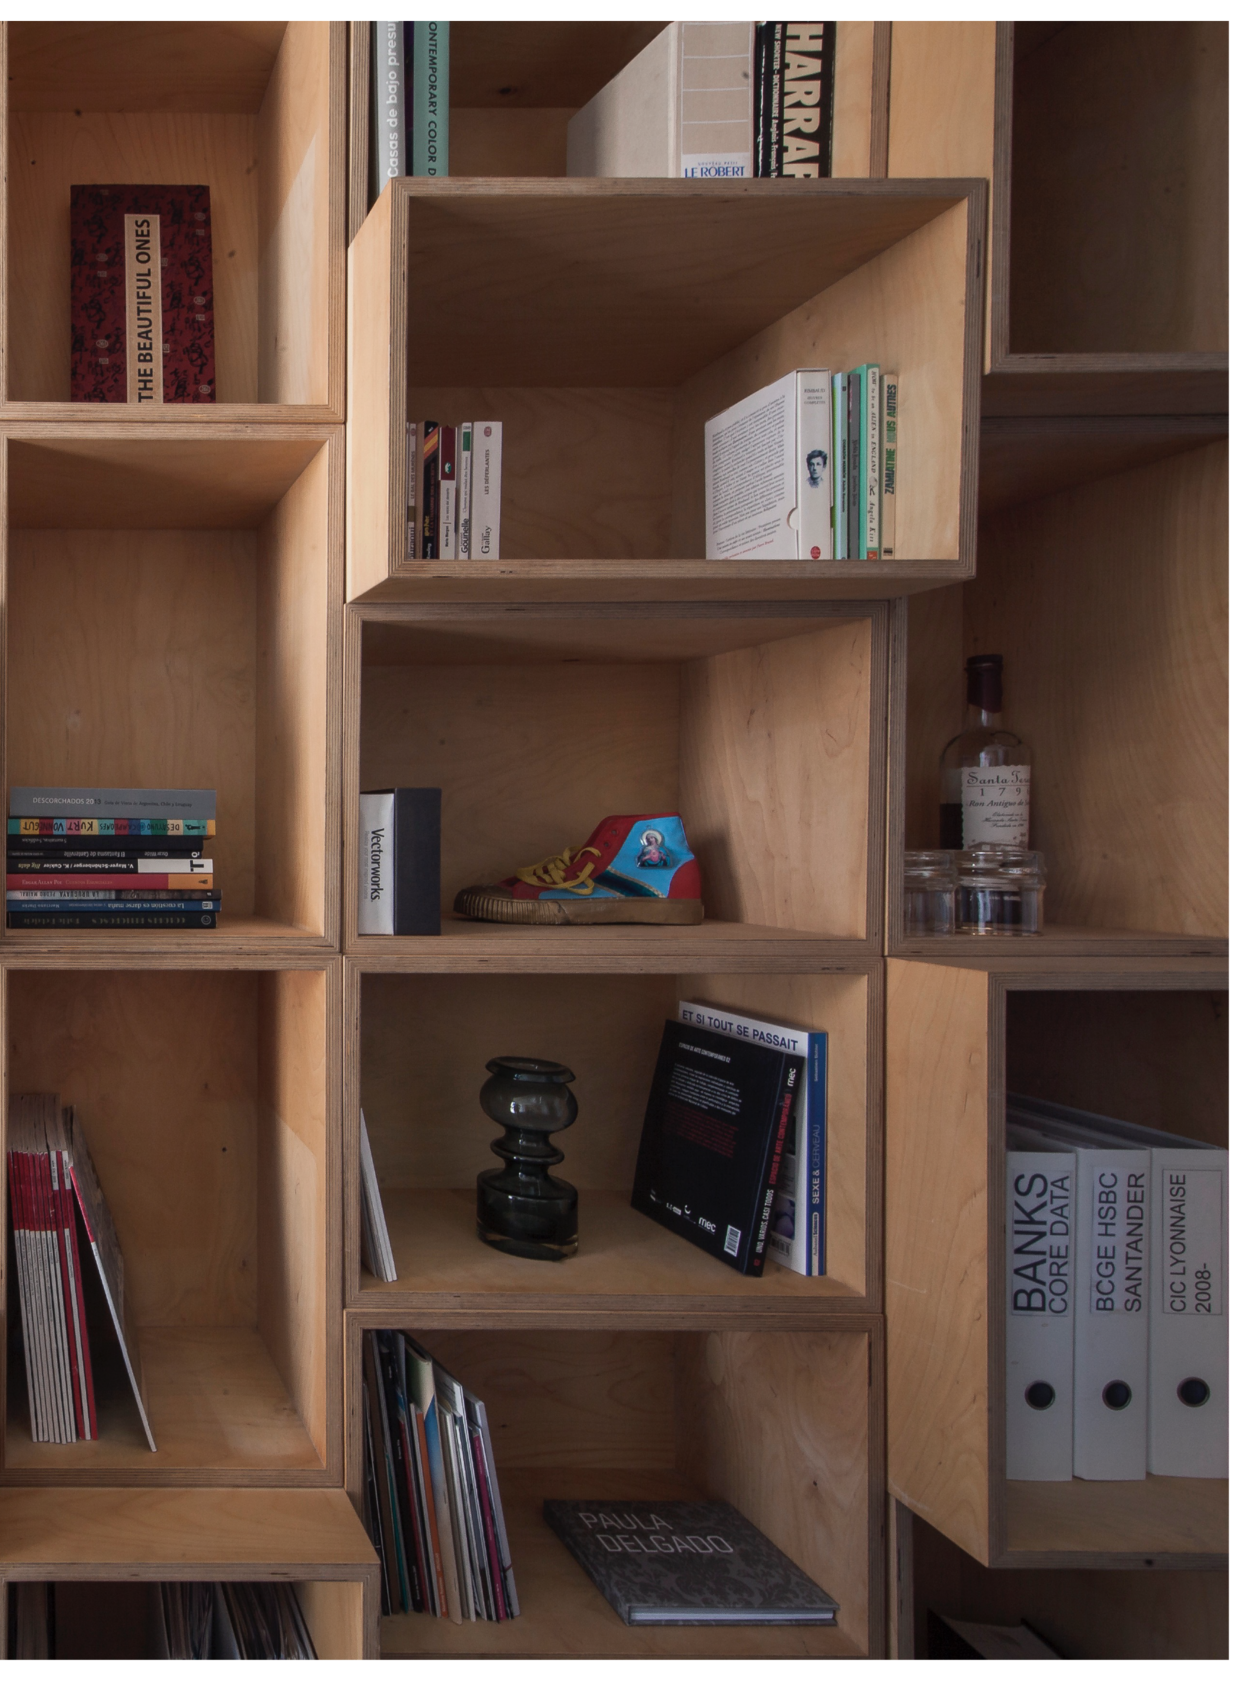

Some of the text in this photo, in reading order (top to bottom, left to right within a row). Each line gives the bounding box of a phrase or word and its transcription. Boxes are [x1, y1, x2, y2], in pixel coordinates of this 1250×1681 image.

[771, 24, 783, 118] NEW SHORTER DICTIONNAIRE
[385, 70, 400, 178] Casas de bajo
[427, 120, 438, 163] COLOR
[684, 166, 746, 178] LE ROBERT
[135, 218, 154, 403] THE BEAUTIFUL ONES
[870, 441, 878, 474] ENGLAND
[884, 384, 898, 495] ZAMIATINE AUTRES
[461, 518, 470, 554] Gounelle
[480, 525, 492, 554] Gallay
[967, 771, 1010, 785] Santa
[32, 797, 85, 805] DESCORCHADOS
[986, 800, 1017, 808] Antiguo
[22, 821, 94, 834] KURT VONNEGUT
[150, 902, 177, 910] cuestión
[682, 1009, 799, 1052] ET SI TOUT SE PASSAIT
[786, 1067, 797, 1088] mec
[811, 1124, 821, 1205] SEXE & CERVEAU
[698, 1216, 717, 1233] mec
[758, 1189, 774, 1240] VARIOS, CASI TODOS
[1013, 1172, 1049, 1313] BANKS
[1048, 1174, 1070, 1314] CORE DATA
[1095, 1172, 1118, 1312] BCGE HSBC
[1124, 1172, 1146, 1313] SANTANDER
[1169, 1174, 1187, 1313] CIC LYONNAISE
[1194, 1262, 1212, 1314] 2008-
[578, 1512, 673, 1530] PAULA
[596, 1534, 734, 1553] DELGADO
